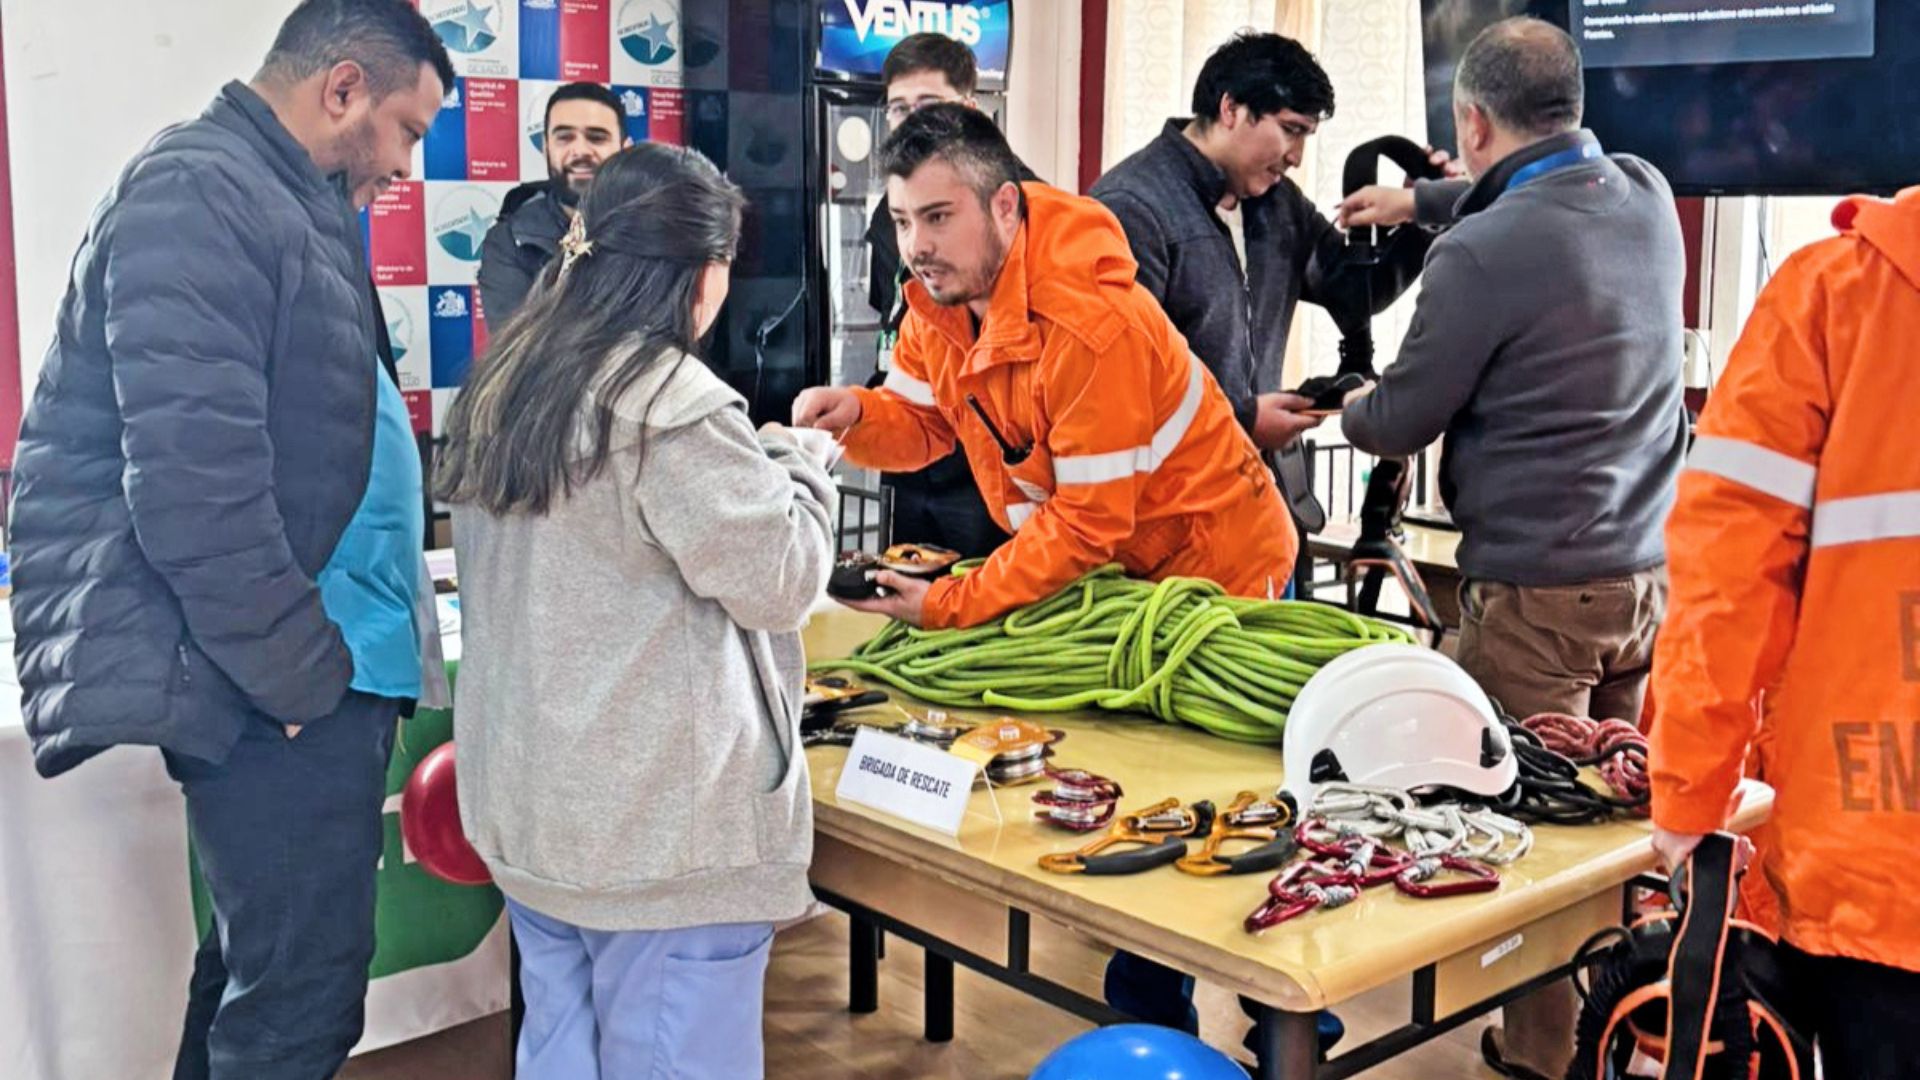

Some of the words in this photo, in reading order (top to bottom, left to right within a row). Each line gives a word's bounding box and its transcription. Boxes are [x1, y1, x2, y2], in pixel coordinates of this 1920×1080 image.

[844, 0, 981, 46] VENTUS
[858, 754, 896, 784] BRIGADA
[895, 766, 912, 785] DE
[910, 770, 951, 799] RESCATE
